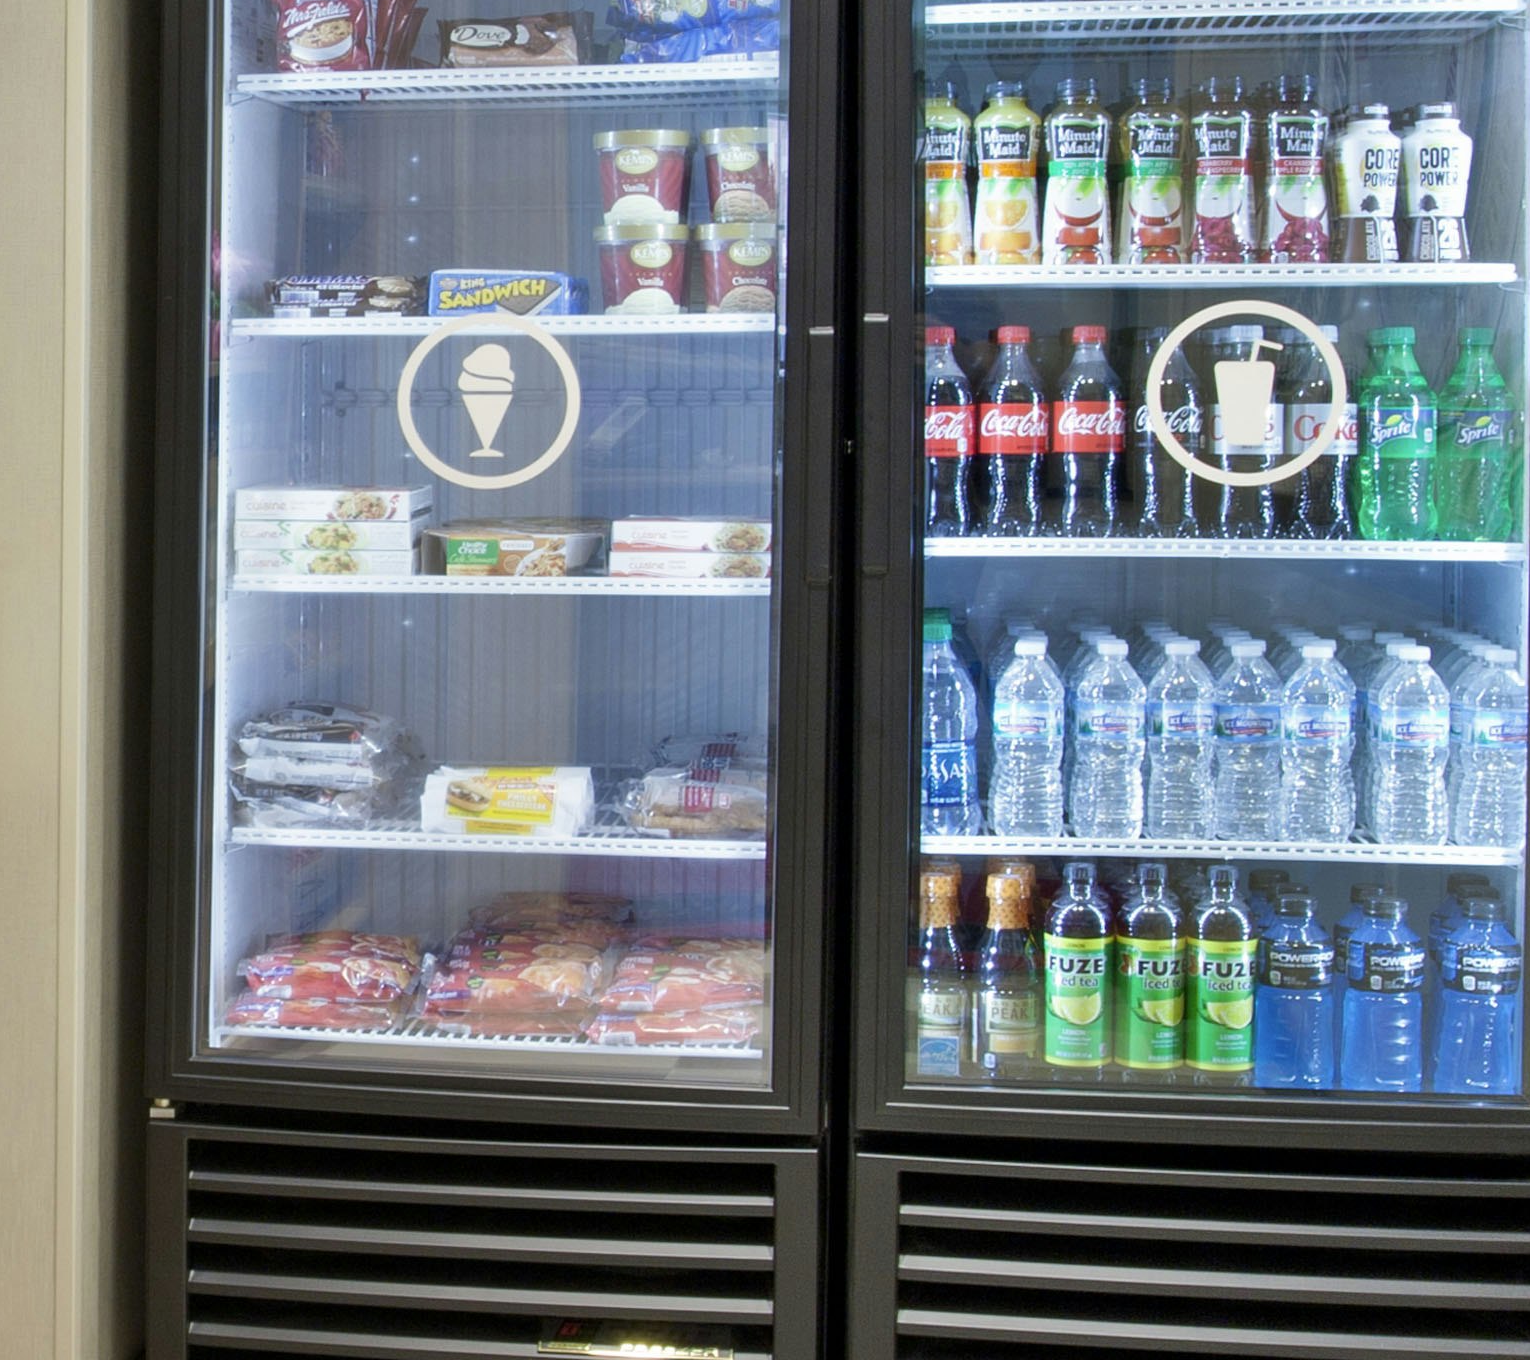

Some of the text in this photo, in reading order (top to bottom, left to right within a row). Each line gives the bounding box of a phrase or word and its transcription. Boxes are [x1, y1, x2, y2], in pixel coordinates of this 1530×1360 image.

[438, 278, 547, 311] SANDWICH
[1370, 420, 1412, 444] Sprite
[1049, 956, 1105, 974] FUZE
[1078, 977, 1099, 987] tea
